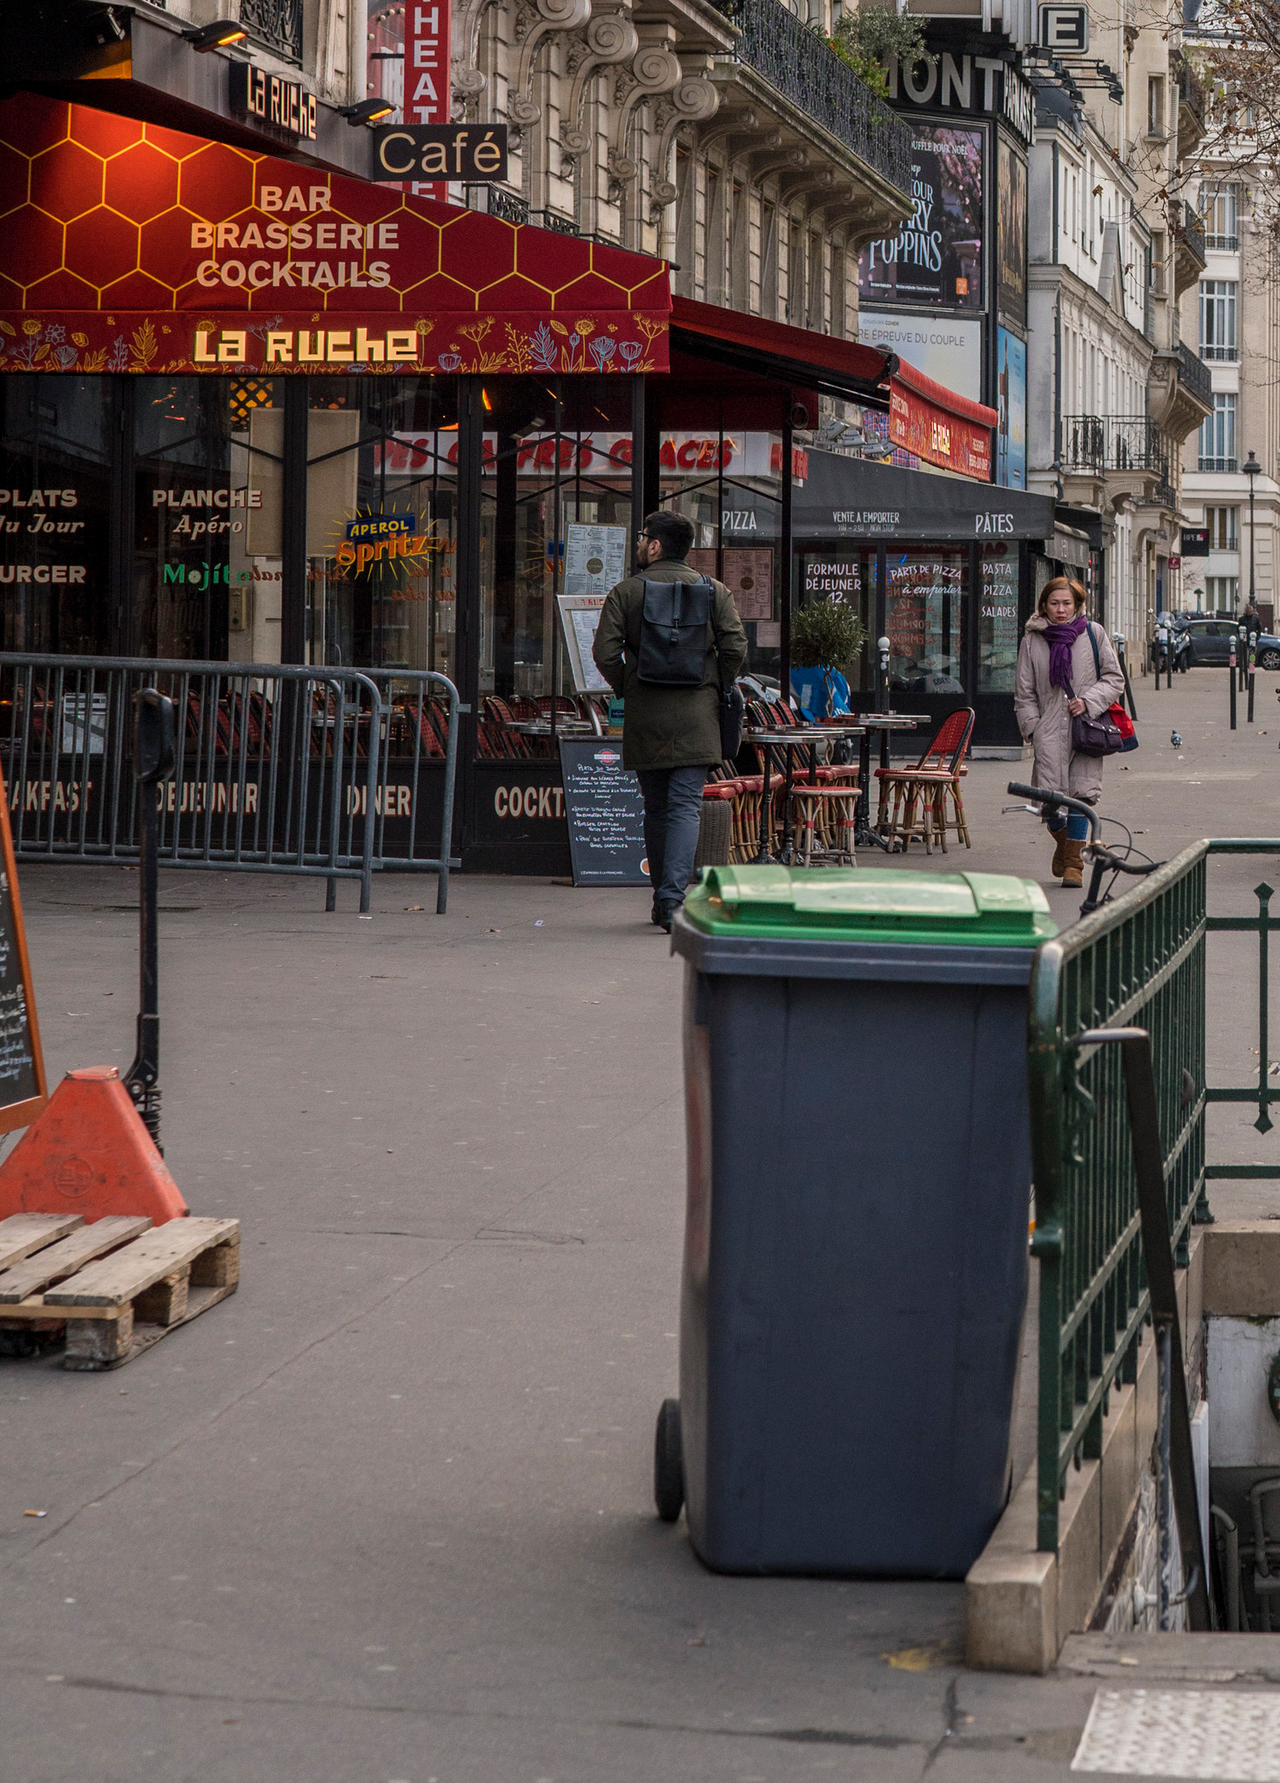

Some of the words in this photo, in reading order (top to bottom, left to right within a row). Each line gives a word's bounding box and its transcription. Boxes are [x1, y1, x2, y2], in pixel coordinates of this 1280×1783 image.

[379, 131, 501, 174] Café
[933, 143, 950, 154] POUR
[951, 145, 968, 156] NOËL
[260, 185, 332, 212] BAR
[190, 222, 399, 249] BRASSERIE
[196, 259, 391, 288] COCKTAILS
[915, 332, 928, 344] DU
[930, 334, 965, 347] COUPLE
[608, 436, 735, 468] GACES
[152, 489, 263, 509] PLANCHE
[27, 513, 85, 534] Jour
[172, 514, 244, 541] Apéro
[350, 520, 409, 537] APEROL
[722, 510, 757, 530] PIZZA
[832, 511, 855, 523] VENTE
[862, 511, 900, 524] EMPORTER
[975, 511, 1015, 534] PÂTES
[335, 531, 429, 573] Spritz
[806, 563, 859, 576] FORMULE
[889, 564, 918, 581] PARTS
[919, 564, 929, 574] DE
[932, 563, 962, 580] PIZZA
[982, 563, 1012, 575] PASTA
[805, 575, 862, 591] DÉJEUNER
[902, 583, 912, 594] à
[913, 578, 963, 599] emporter
[983, 584, 1013, 596] PIZZA
[981, 605, 1017, 618] SALADES
[494, 785, 566, 818] COCKT
